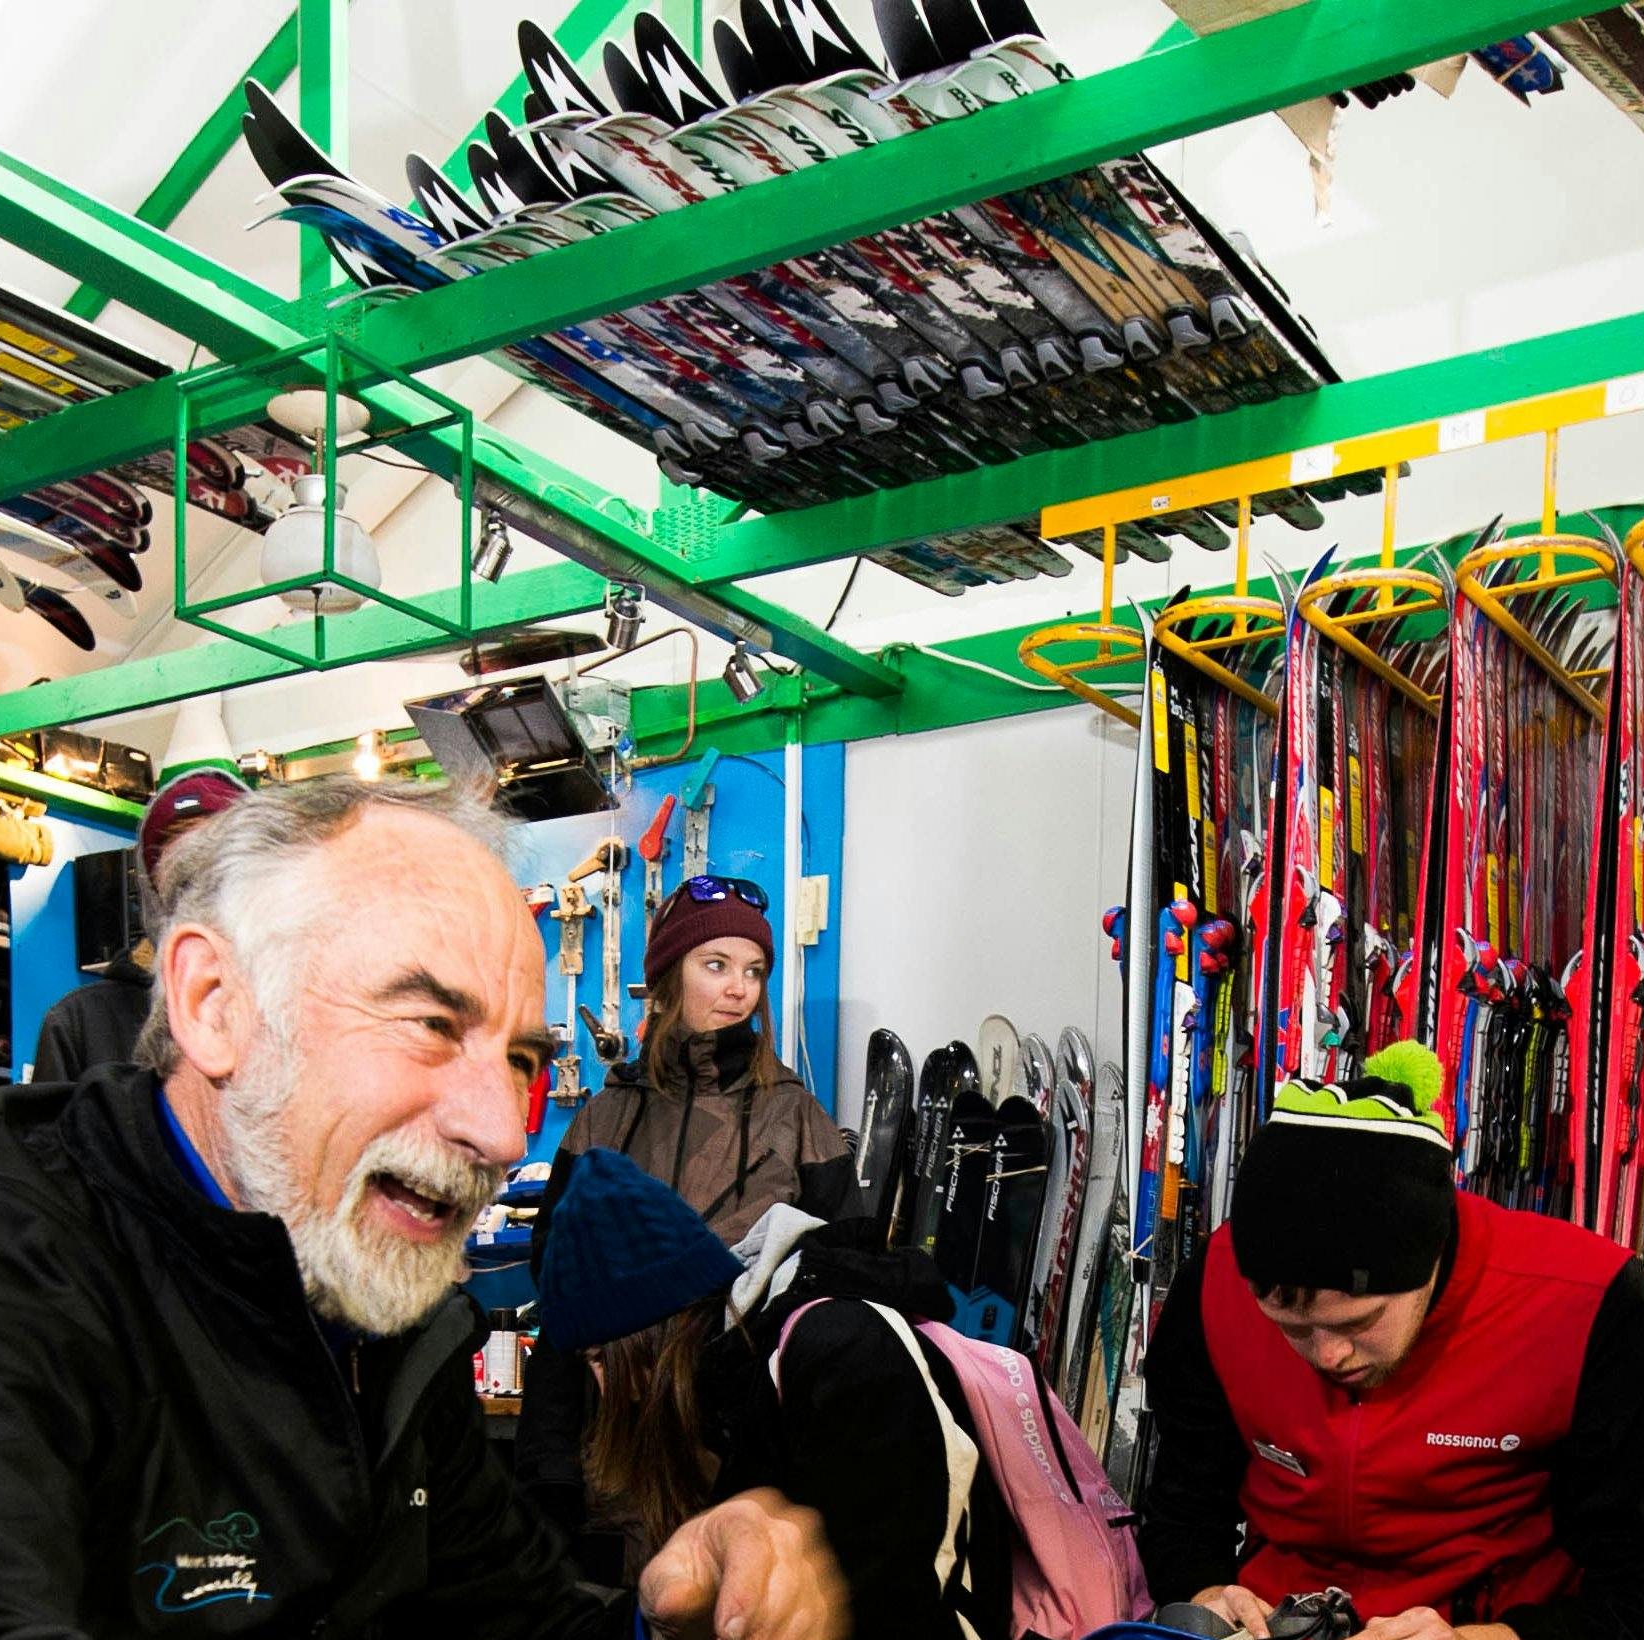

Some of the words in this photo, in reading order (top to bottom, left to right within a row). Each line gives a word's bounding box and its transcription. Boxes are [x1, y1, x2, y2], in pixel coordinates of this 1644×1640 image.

[914, 1110, 929, 1177] FISCHER
[925, 1111, 944, 1179] FISCHER
[945, 1142, 961, 1213] FISCHER
[986, 1150, 1004, 1221] FISCHER
[1019, 1406, 1052, 1475] adidas
